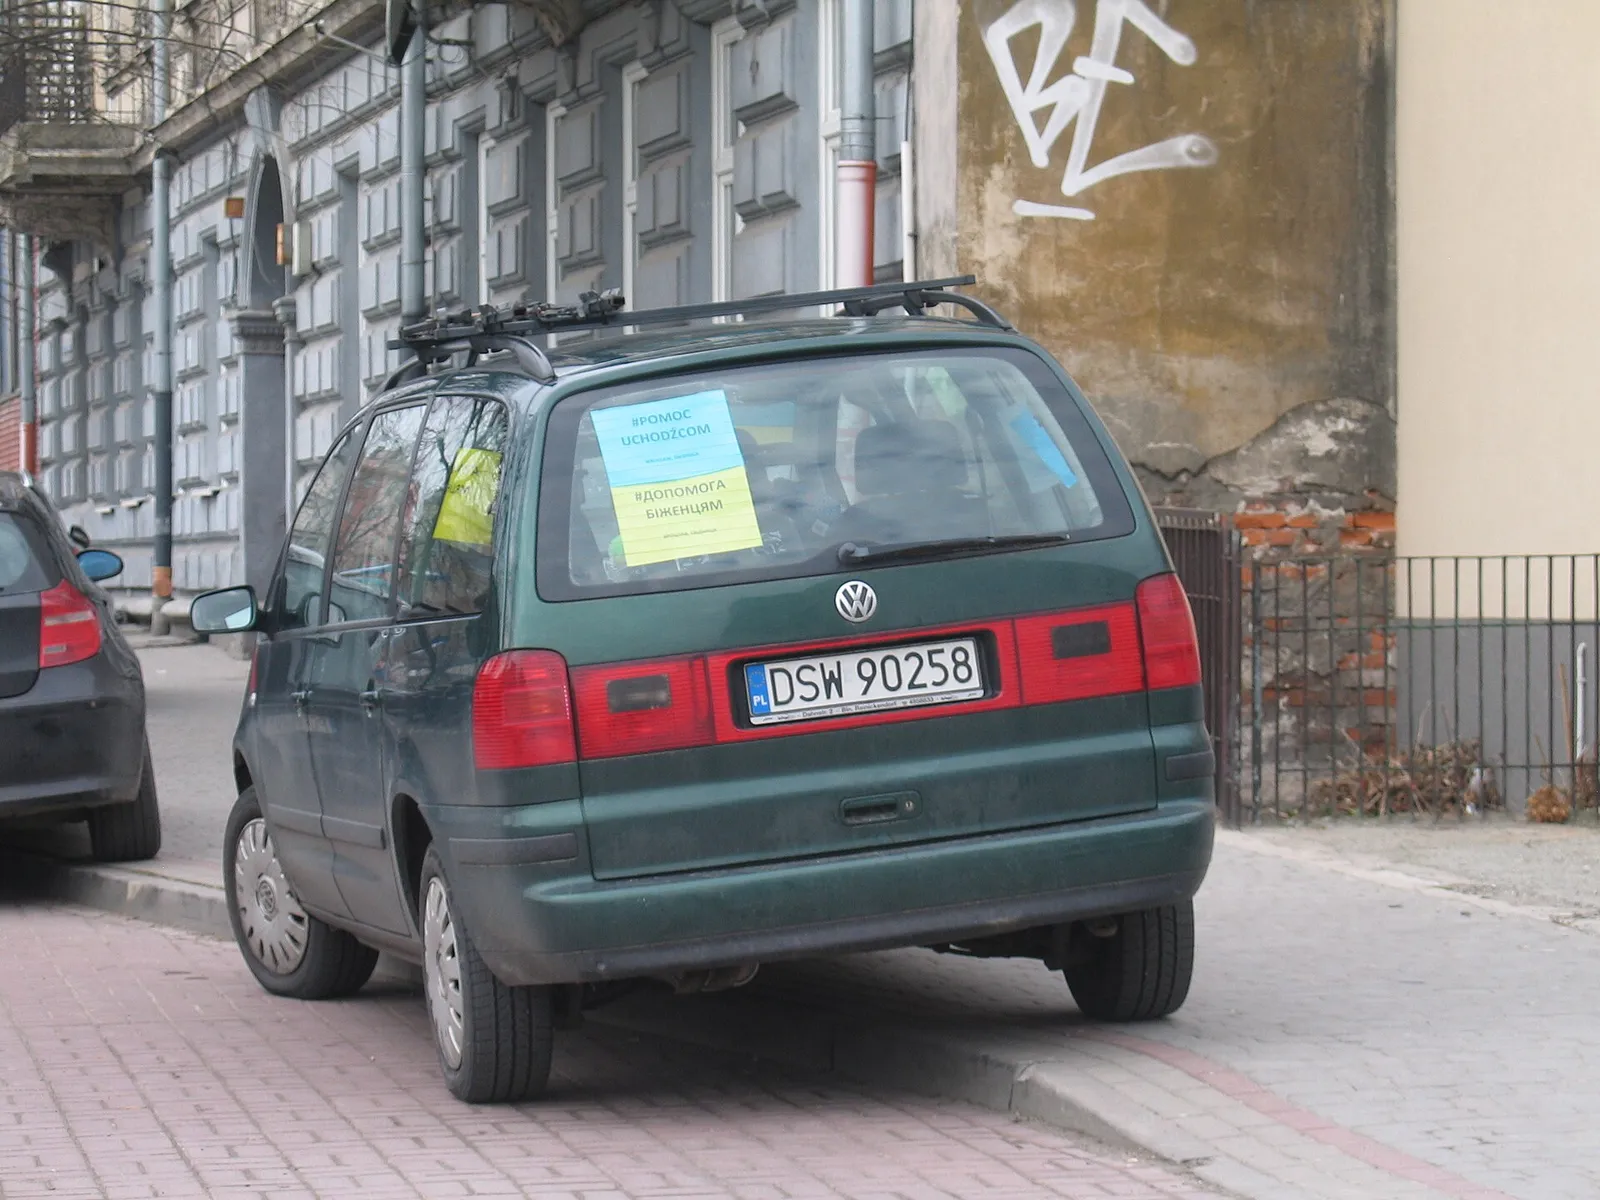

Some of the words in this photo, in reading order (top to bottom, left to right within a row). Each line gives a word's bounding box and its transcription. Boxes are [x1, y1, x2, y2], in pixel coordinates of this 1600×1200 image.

[632, 409, 692, 427] #POMOC
[621, 423, 711, 446] UCHODŹCOM
[634, 479, 726, 503] #ДОПОМОГА
[646, 499, 724, 520] БІЖЕНЦЯМ
[769, 660, 844, 707] DSW
[856, 646, 973, 696] 90258
[752, 695, 768, 707] PL
